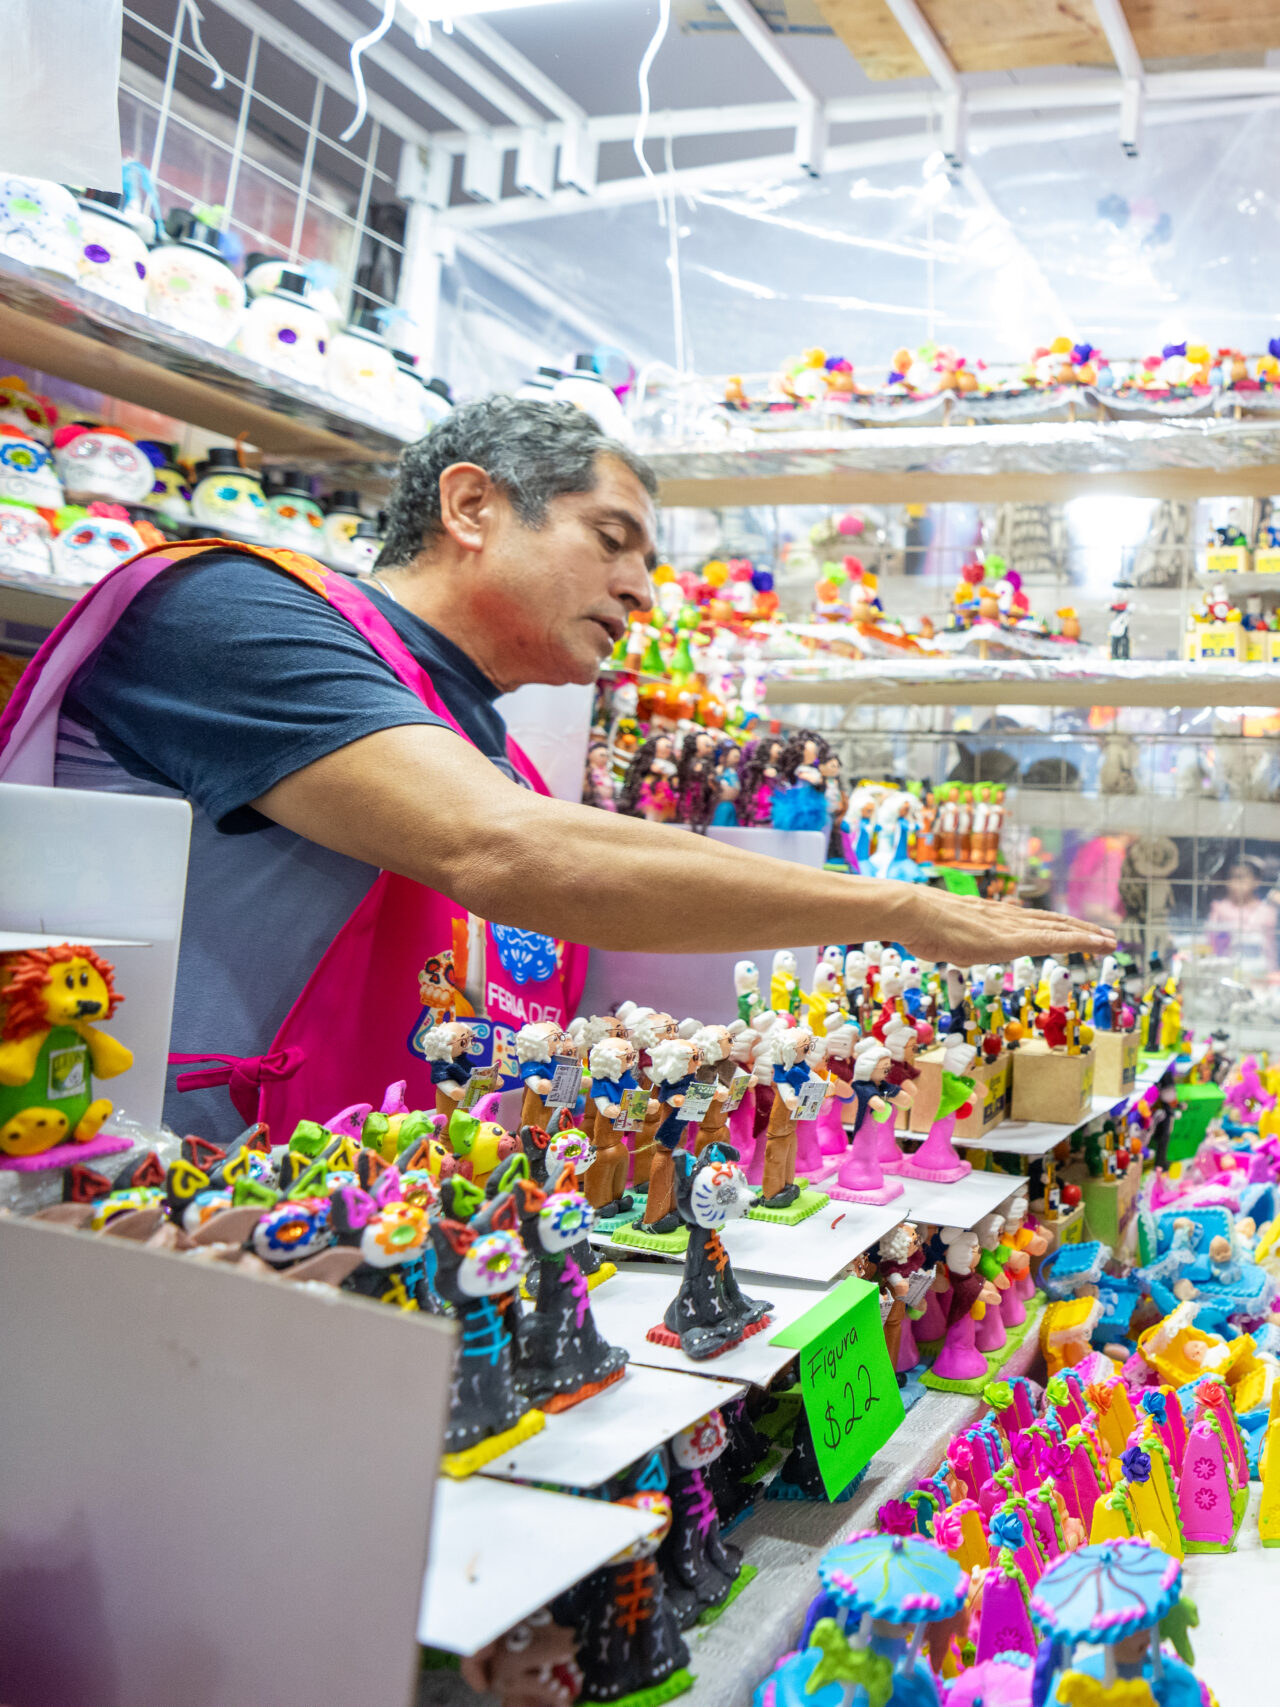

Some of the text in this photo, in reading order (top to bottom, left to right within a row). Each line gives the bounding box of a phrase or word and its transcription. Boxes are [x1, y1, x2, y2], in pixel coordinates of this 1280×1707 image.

[488, 982, 528, 1022] FERIA
[807, 1327, 859, 1388] Figura
[823, 1364, 880, 1449] $22
